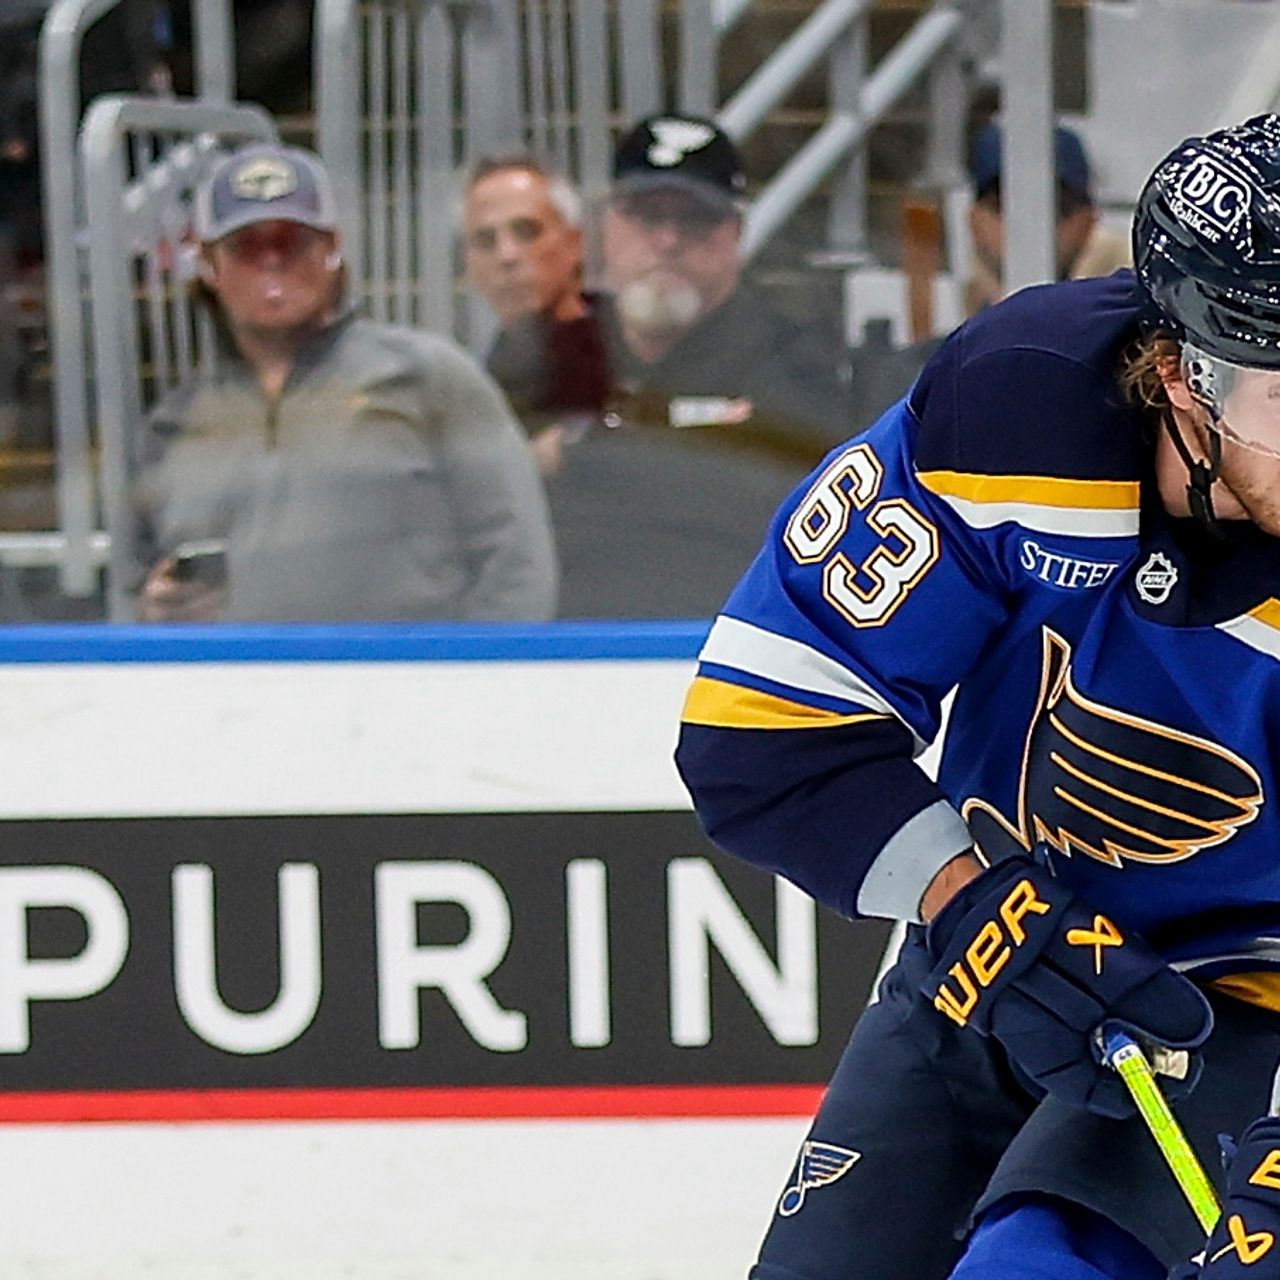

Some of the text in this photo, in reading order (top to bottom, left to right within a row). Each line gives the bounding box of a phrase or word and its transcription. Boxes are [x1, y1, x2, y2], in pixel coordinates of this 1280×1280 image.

[1183, 164, 1245, 218] BJC
[784, 443, 939, 628] 63
[0, 857, 906, 1055] PURIN
